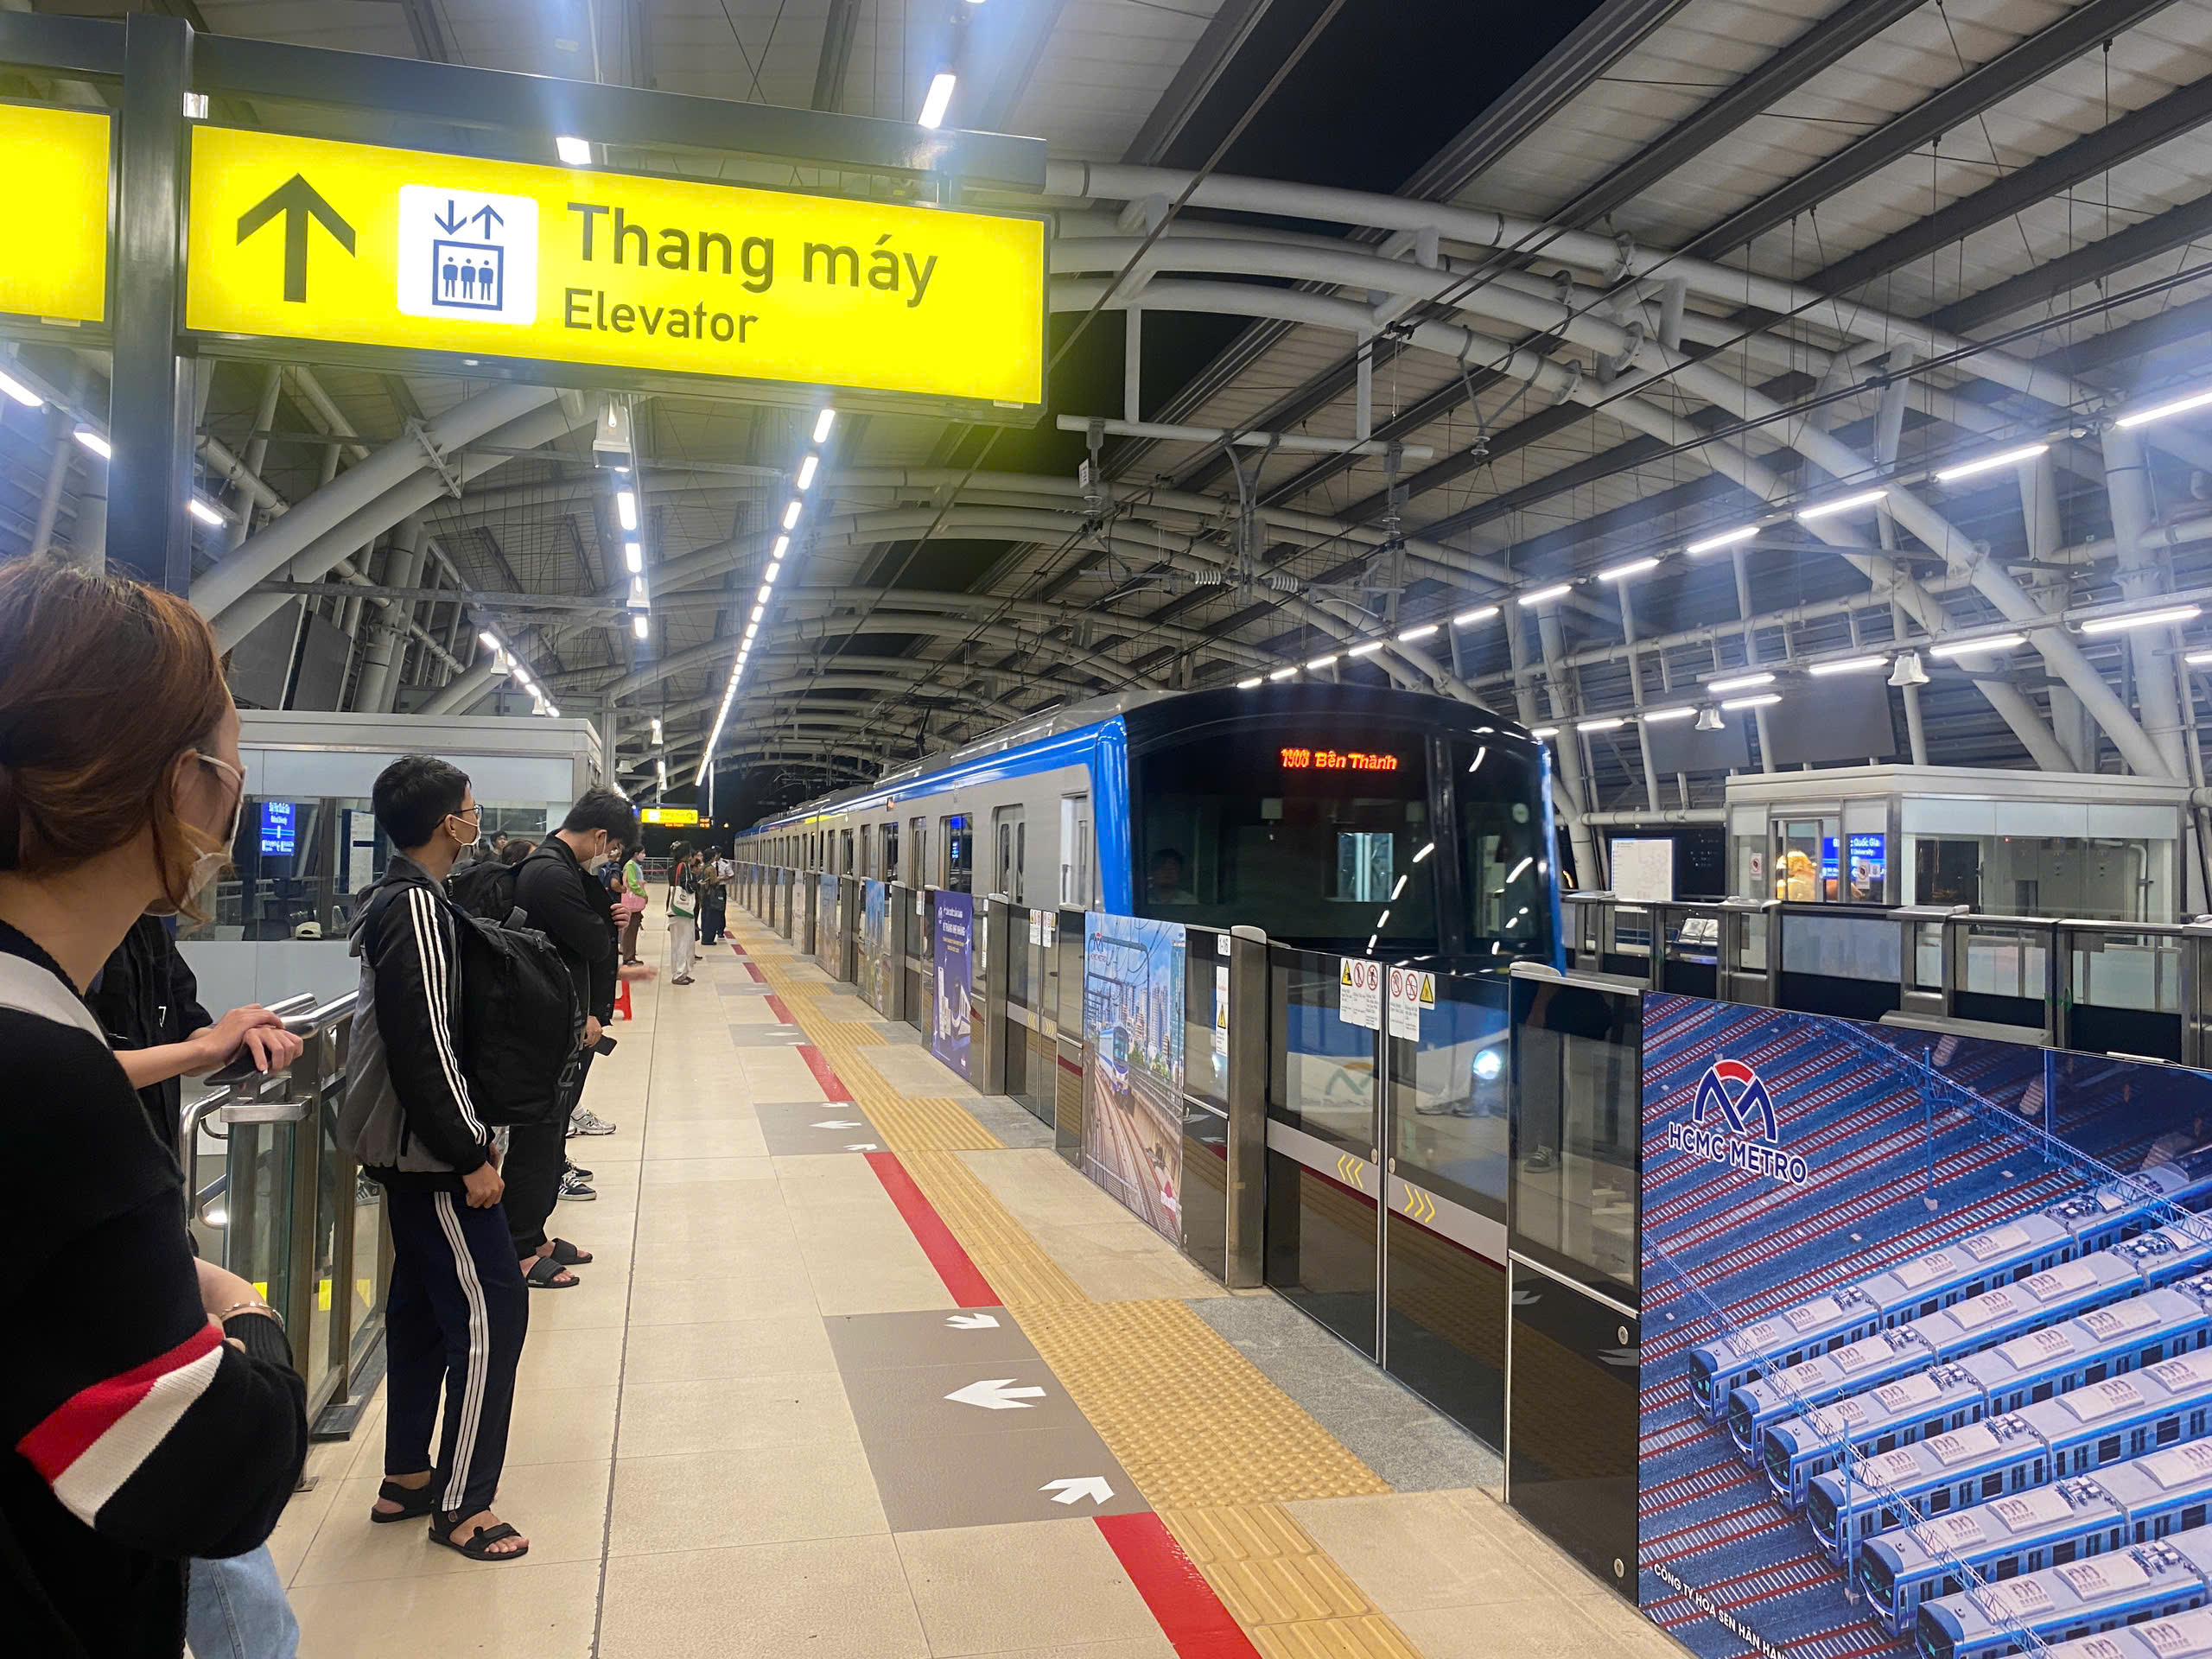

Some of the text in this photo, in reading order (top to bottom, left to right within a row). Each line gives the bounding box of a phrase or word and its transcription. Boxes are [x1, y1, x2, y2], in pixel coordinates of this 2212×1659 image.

[567, 201, 938, 308] Thang máy
[564, 287, 760, 343] Elevator
[1669, 1122, 1808, 1185] HCMC METRO
[1654, 1564, 1681, 1589] CÔNG
[1683, 1583, 1694, 1599] TY
[1695, 1592, 1717, 1618] HOA
[1718, 1610, 1736, 1632] SEN
[1738, 1624, 1761, 1649] HÂN
